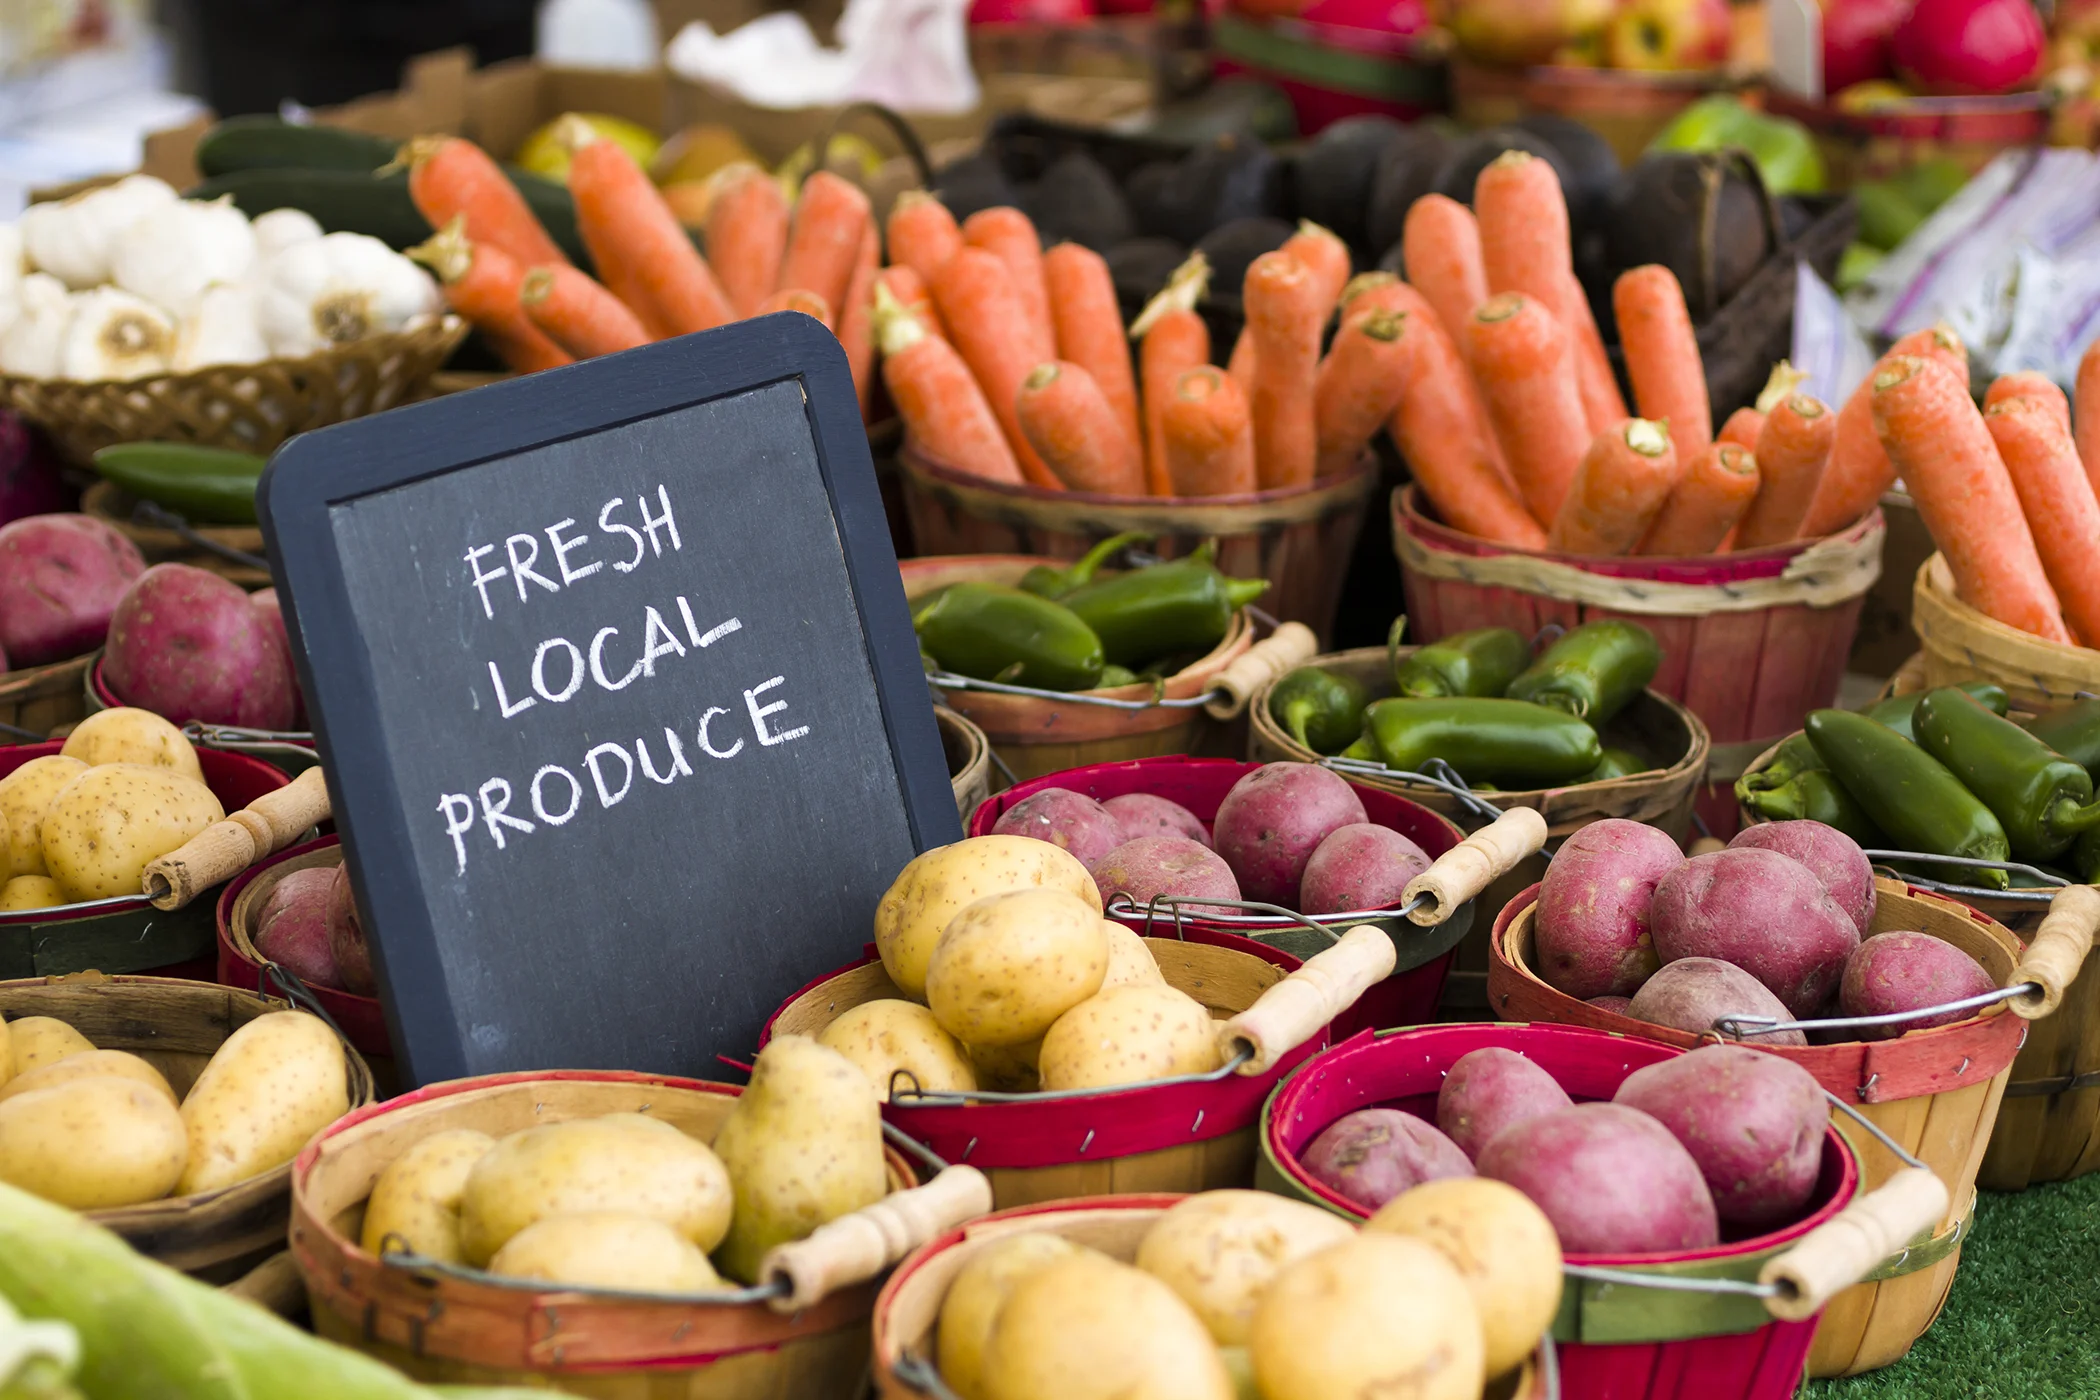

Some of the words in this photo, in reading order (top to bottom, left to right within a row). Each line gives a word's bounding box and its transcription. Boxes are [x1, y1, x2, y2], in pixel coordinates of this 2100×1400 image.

[463, 484, 682, 620] FRESH
[488, 596, 742, 719] LOCAL
[436, 675, 810, 877] PRODUCE
